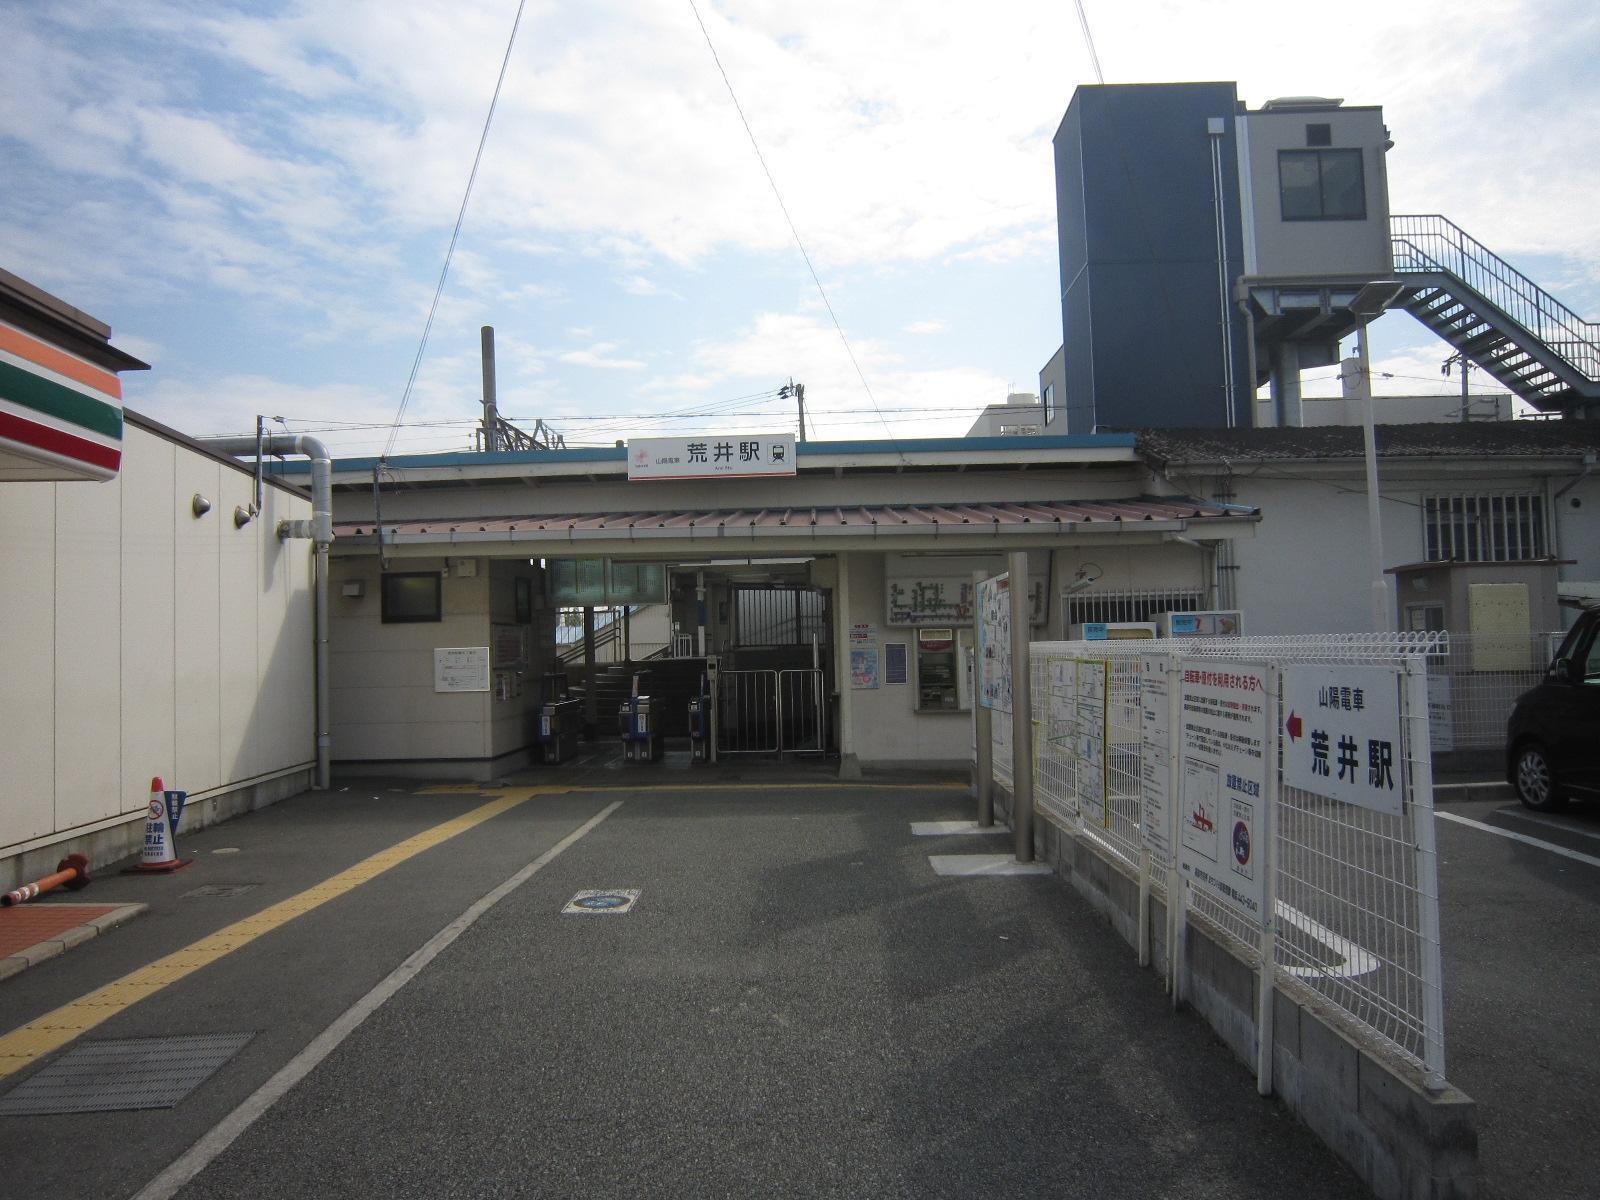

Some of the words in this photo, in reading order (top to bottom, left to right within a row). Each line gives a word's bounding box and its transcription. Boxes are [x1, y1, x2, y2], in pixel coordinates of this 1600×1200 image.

[655, 457, 680, 465] 山陽電車
[687, 441, 760, 464] 荒井駅
[1318, 685, 1365, 712] 山陽電車
[1311, 729, 1394, 792] 荒井駅
